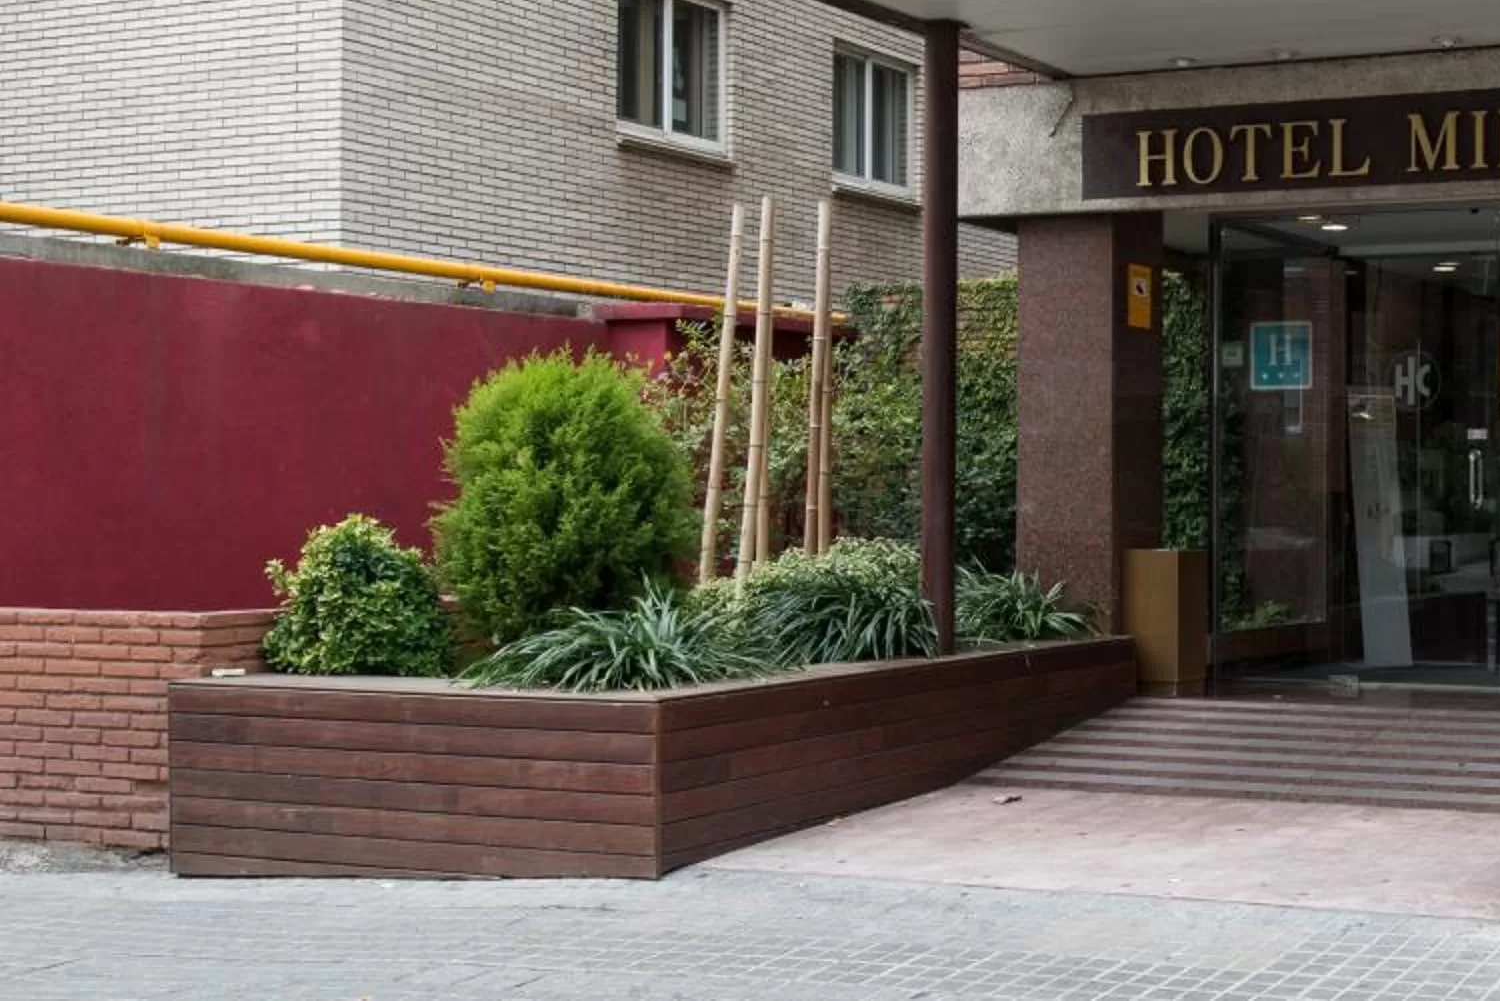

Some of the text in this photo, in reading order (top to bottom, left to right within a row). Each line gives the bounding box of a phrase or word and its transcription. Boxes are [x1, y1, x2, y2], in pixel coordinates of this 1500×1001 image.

[1135, 118, 1372, 188] HOTEL
[1269, 334, 1293, 366] H
[1395, 356, 1431, 406] HC
